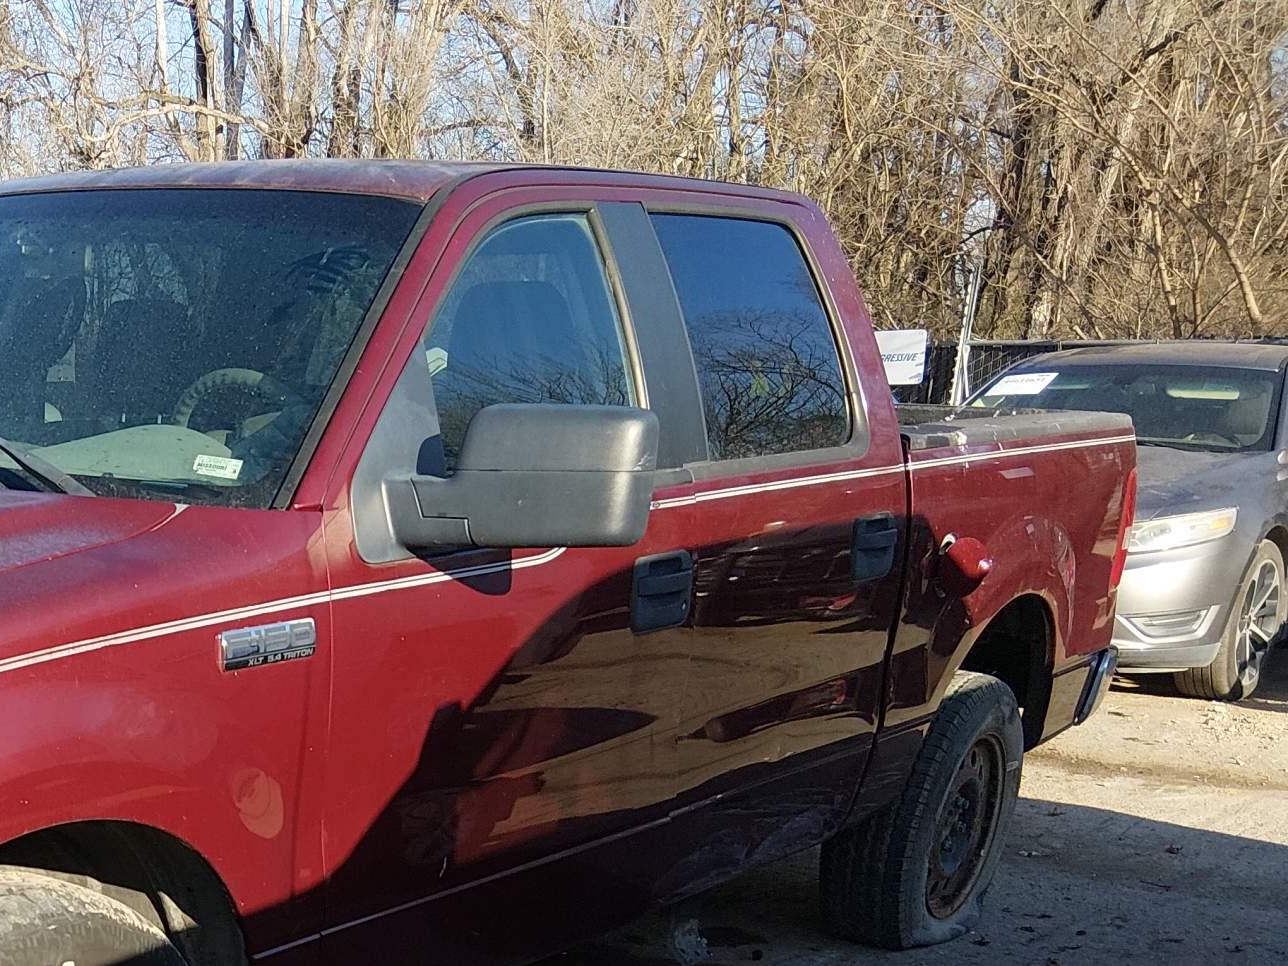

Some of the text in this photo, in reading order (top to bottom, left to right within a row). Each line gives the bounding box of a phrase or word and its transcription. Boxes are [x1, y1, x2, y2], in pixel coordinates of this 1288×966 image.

[247, 647, 314, 666] XLT 5.4 TRITON
